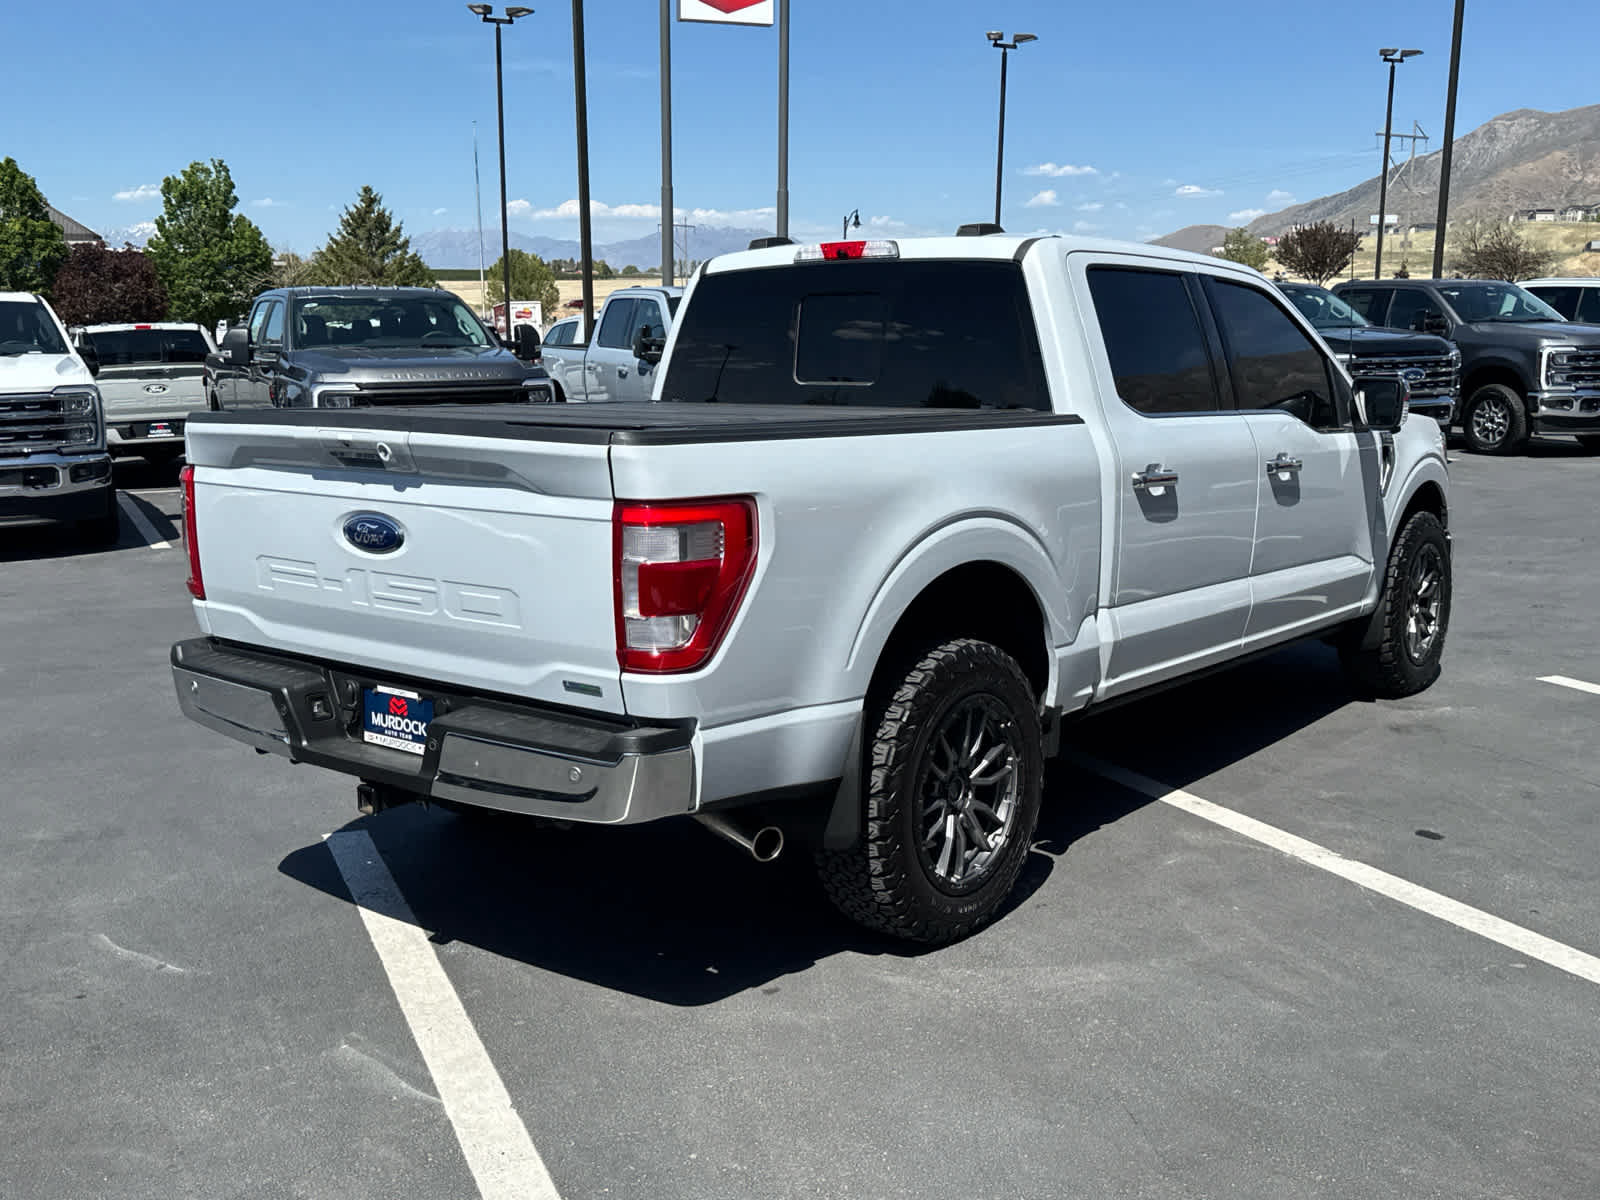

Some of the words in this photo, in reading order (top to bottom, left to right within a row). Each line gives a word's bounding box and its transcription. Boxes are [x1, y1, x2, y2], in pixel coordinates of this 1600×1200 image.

[354, 522, 388, 545] Ford
[256, 554, 521, 628] F-150
[371, 711, 427, 736] MURDOCK
